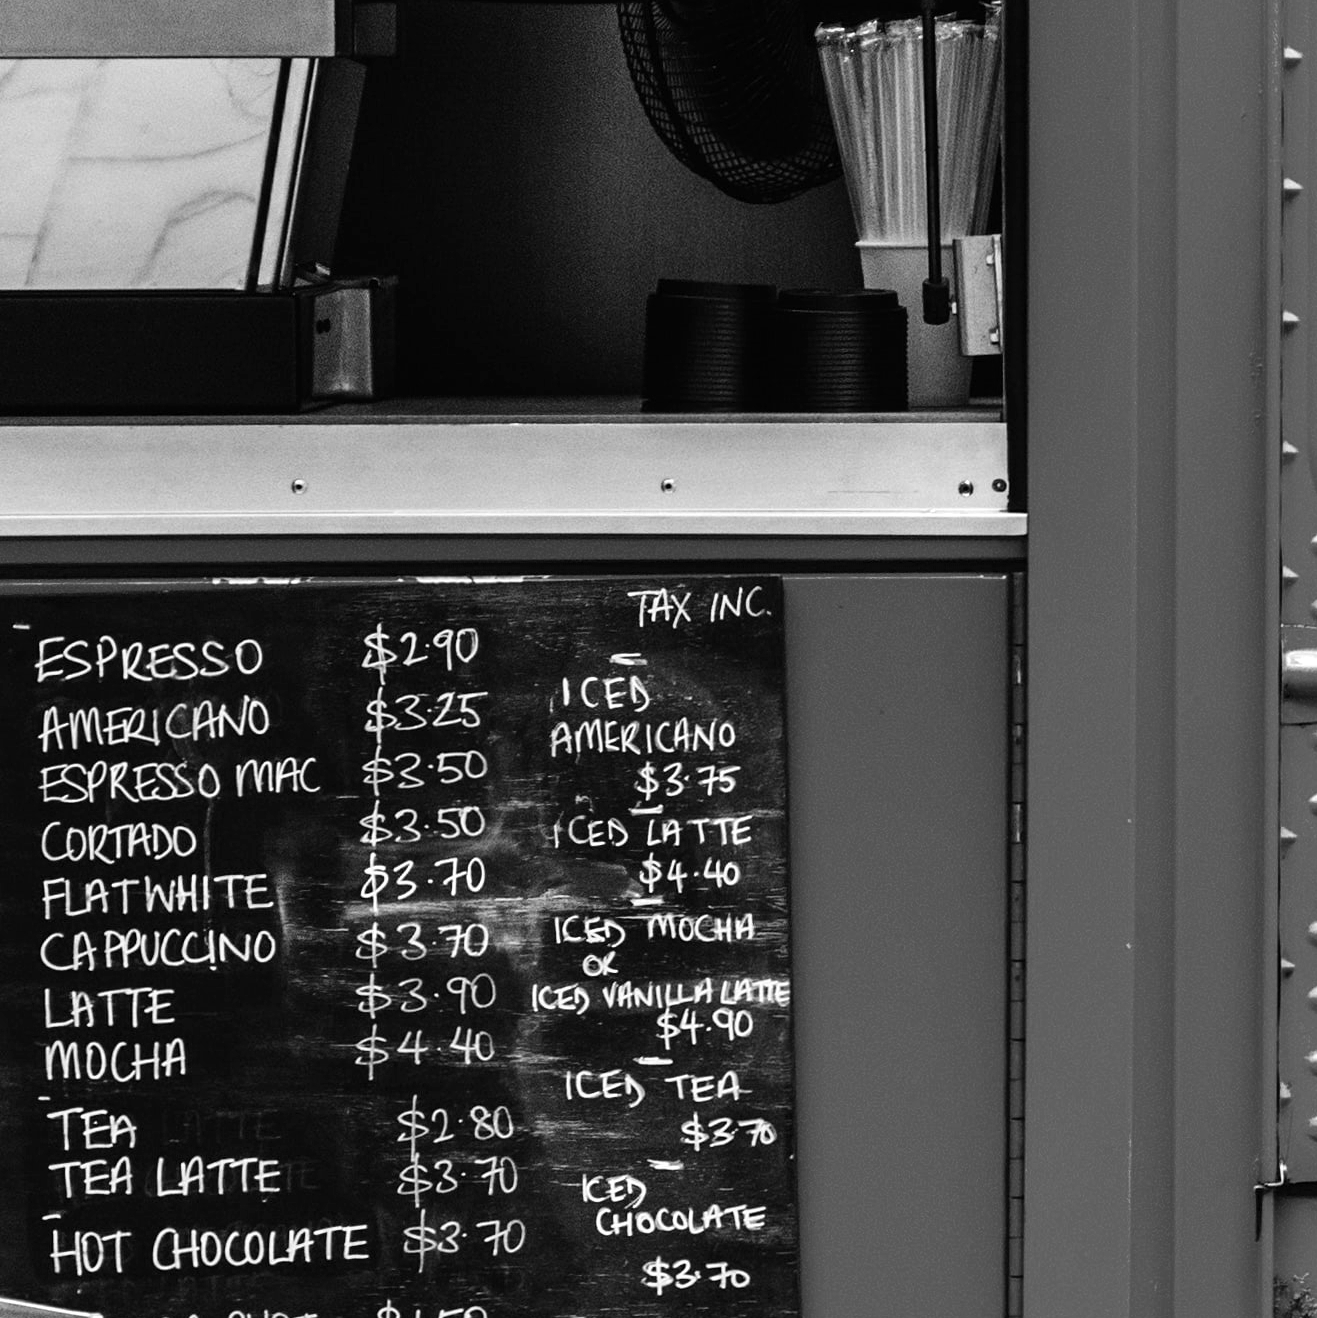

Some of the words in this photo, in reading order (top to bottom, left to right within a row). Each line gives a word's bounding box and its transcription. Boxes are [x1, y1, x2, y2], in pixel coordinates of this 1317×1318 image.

[627, 588, 692, 629] TAX
[34, 635, 263, 683] ESPRESSO
[360, 622, 480, 686] $2.90
[364, 685, 489, 745] $3.25
[562, 675, 651, 713] ICED
[37, 694, 270, 753] AMERICANO
[550, 717, 736, 758] AMERICANO
[38, 760, 221, 803] ESPRESSO
[236, 757, 321, 798] MAC
[361, 744, 488, 797] $3.50
[634, 760, 742, 801] $3.75
[41, 821, 198, 864] CORTADO
[358, 799, 486, 847] $3.50
[552, 814, 629, 849] ICED
[646, 814, 754, 847] LATTE
[359, 851, 486, 914] $3.70
[638, 851, 741, 894] $4.40
[40, 928, 276, 971] CAPPUCCINO
[355, 921, 490, 969] $3.70
[553, 914, 627, 948] ICED
[647, 912, 756, 942] MOCHA
[44, 987, 176, 1029] LATTE
[355, 971, 497, 1020] $3.90
[531, 982, 591, 1015] ICED
[602, 977, 713, 1010] VANILLA
[720, 977, 792, 1008] LATTE
[655, 1007, 754, 1051] $4.90
[45, 1037, 187, 1082] MOCHA
[354, 1023, 496, 1082] $4.40
[565, 1070, 647, 1108] ICED
[665, 1070, 753, 1102] TEA
[46, 1107, 138, 1151] TEA
[396, 1093, 515, 1163] $2.80
[48, 1156, 133, 1198] TEA
[156, 1155, 281, 1197] LATTE
[396, 1152, 519, 1209] $3.70
[581, 1173, 647, 1209] ICED
[403, 1208, 526, 1274] $3.70
[594, 1204, 768, 1237] CHOCOLATE
[50, 1229, 133, 1276] HOT
[152, 1224, 370, 1271] CHOCOLATE
[641, 1255, 752, 1296] $3.70
